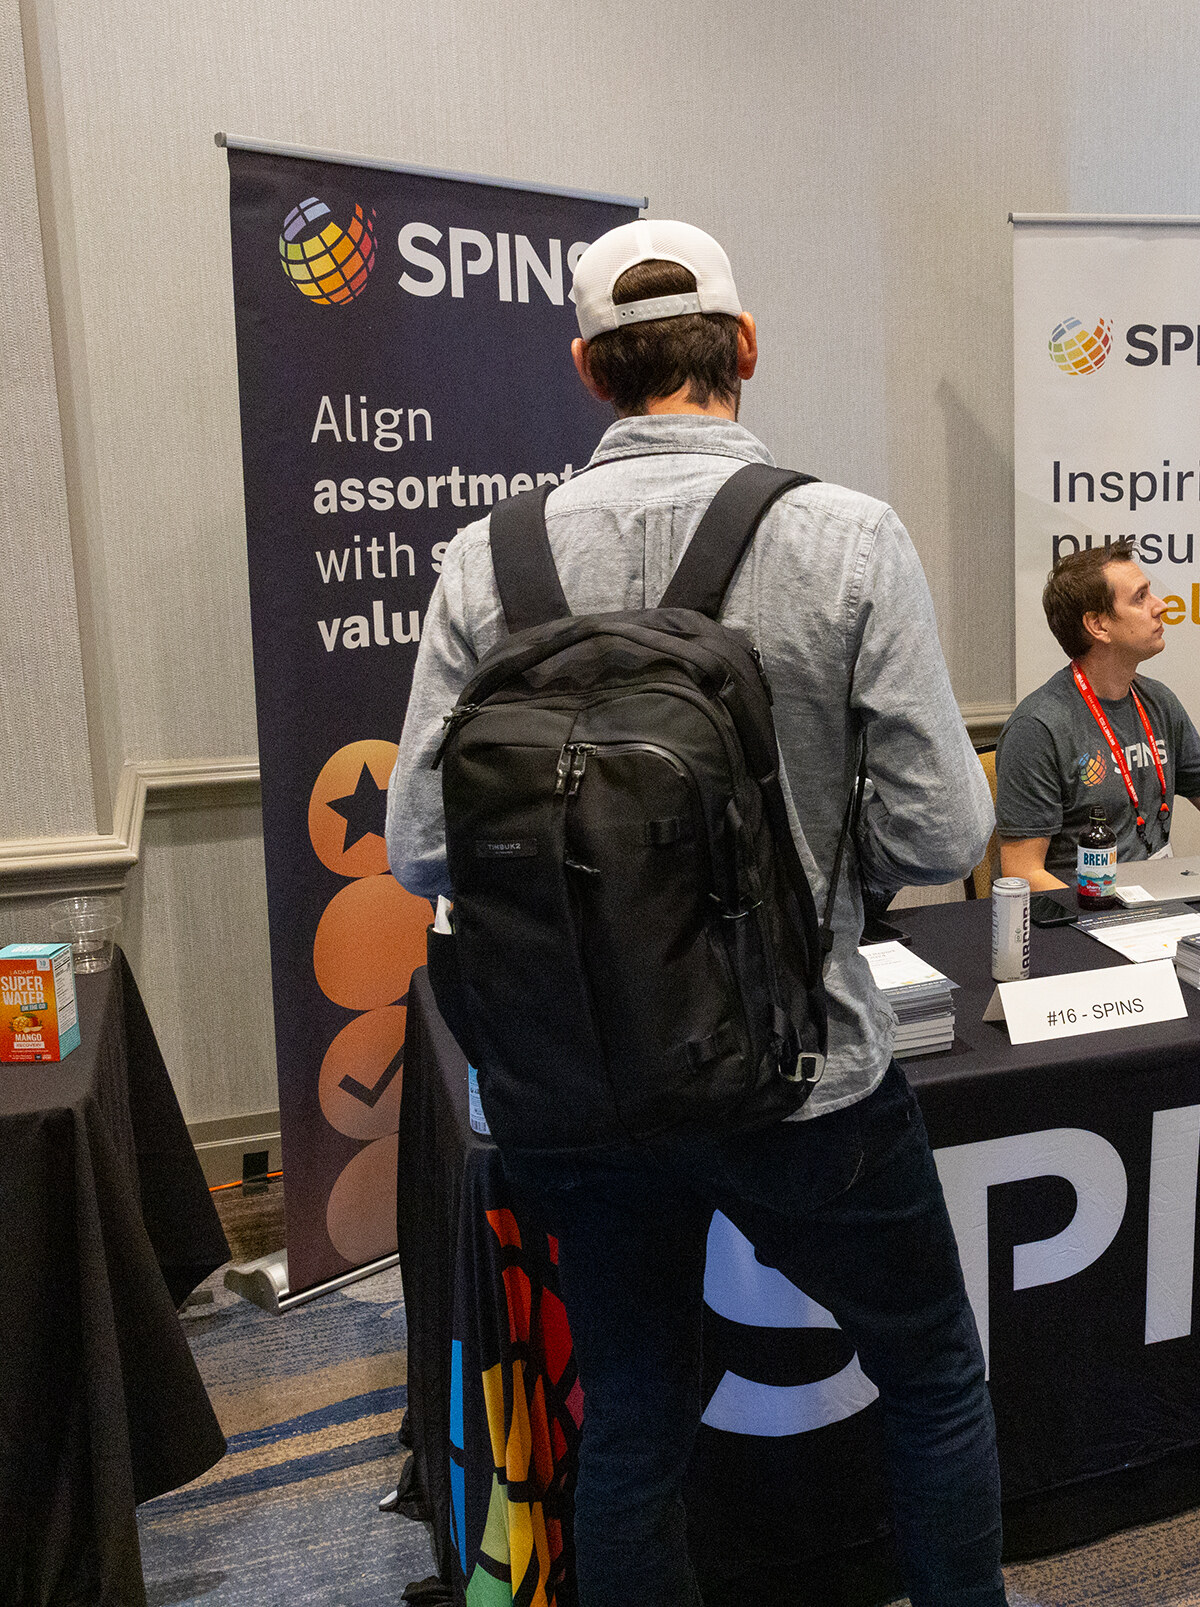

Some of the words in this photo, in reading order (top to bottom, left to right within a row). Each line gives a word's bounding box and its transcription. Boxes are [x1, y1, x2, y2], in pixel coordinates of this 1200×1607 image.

[398, 222, 592, 306] SPIN
[311, 395, 433, 452] Align
[315, 533, 416, 584] with
[317, 601, 421, 652] valu
[1083, 852, 1109, 866] BREW
[0, 975, 44, 991] SUPER
[2, 991, 45, 1006] WATER
[1047, 1008, 1077, 1027] #16
[1092, 998, 1144, 1019] SPINS
[15, 1033, 42, 1042] MANGO
